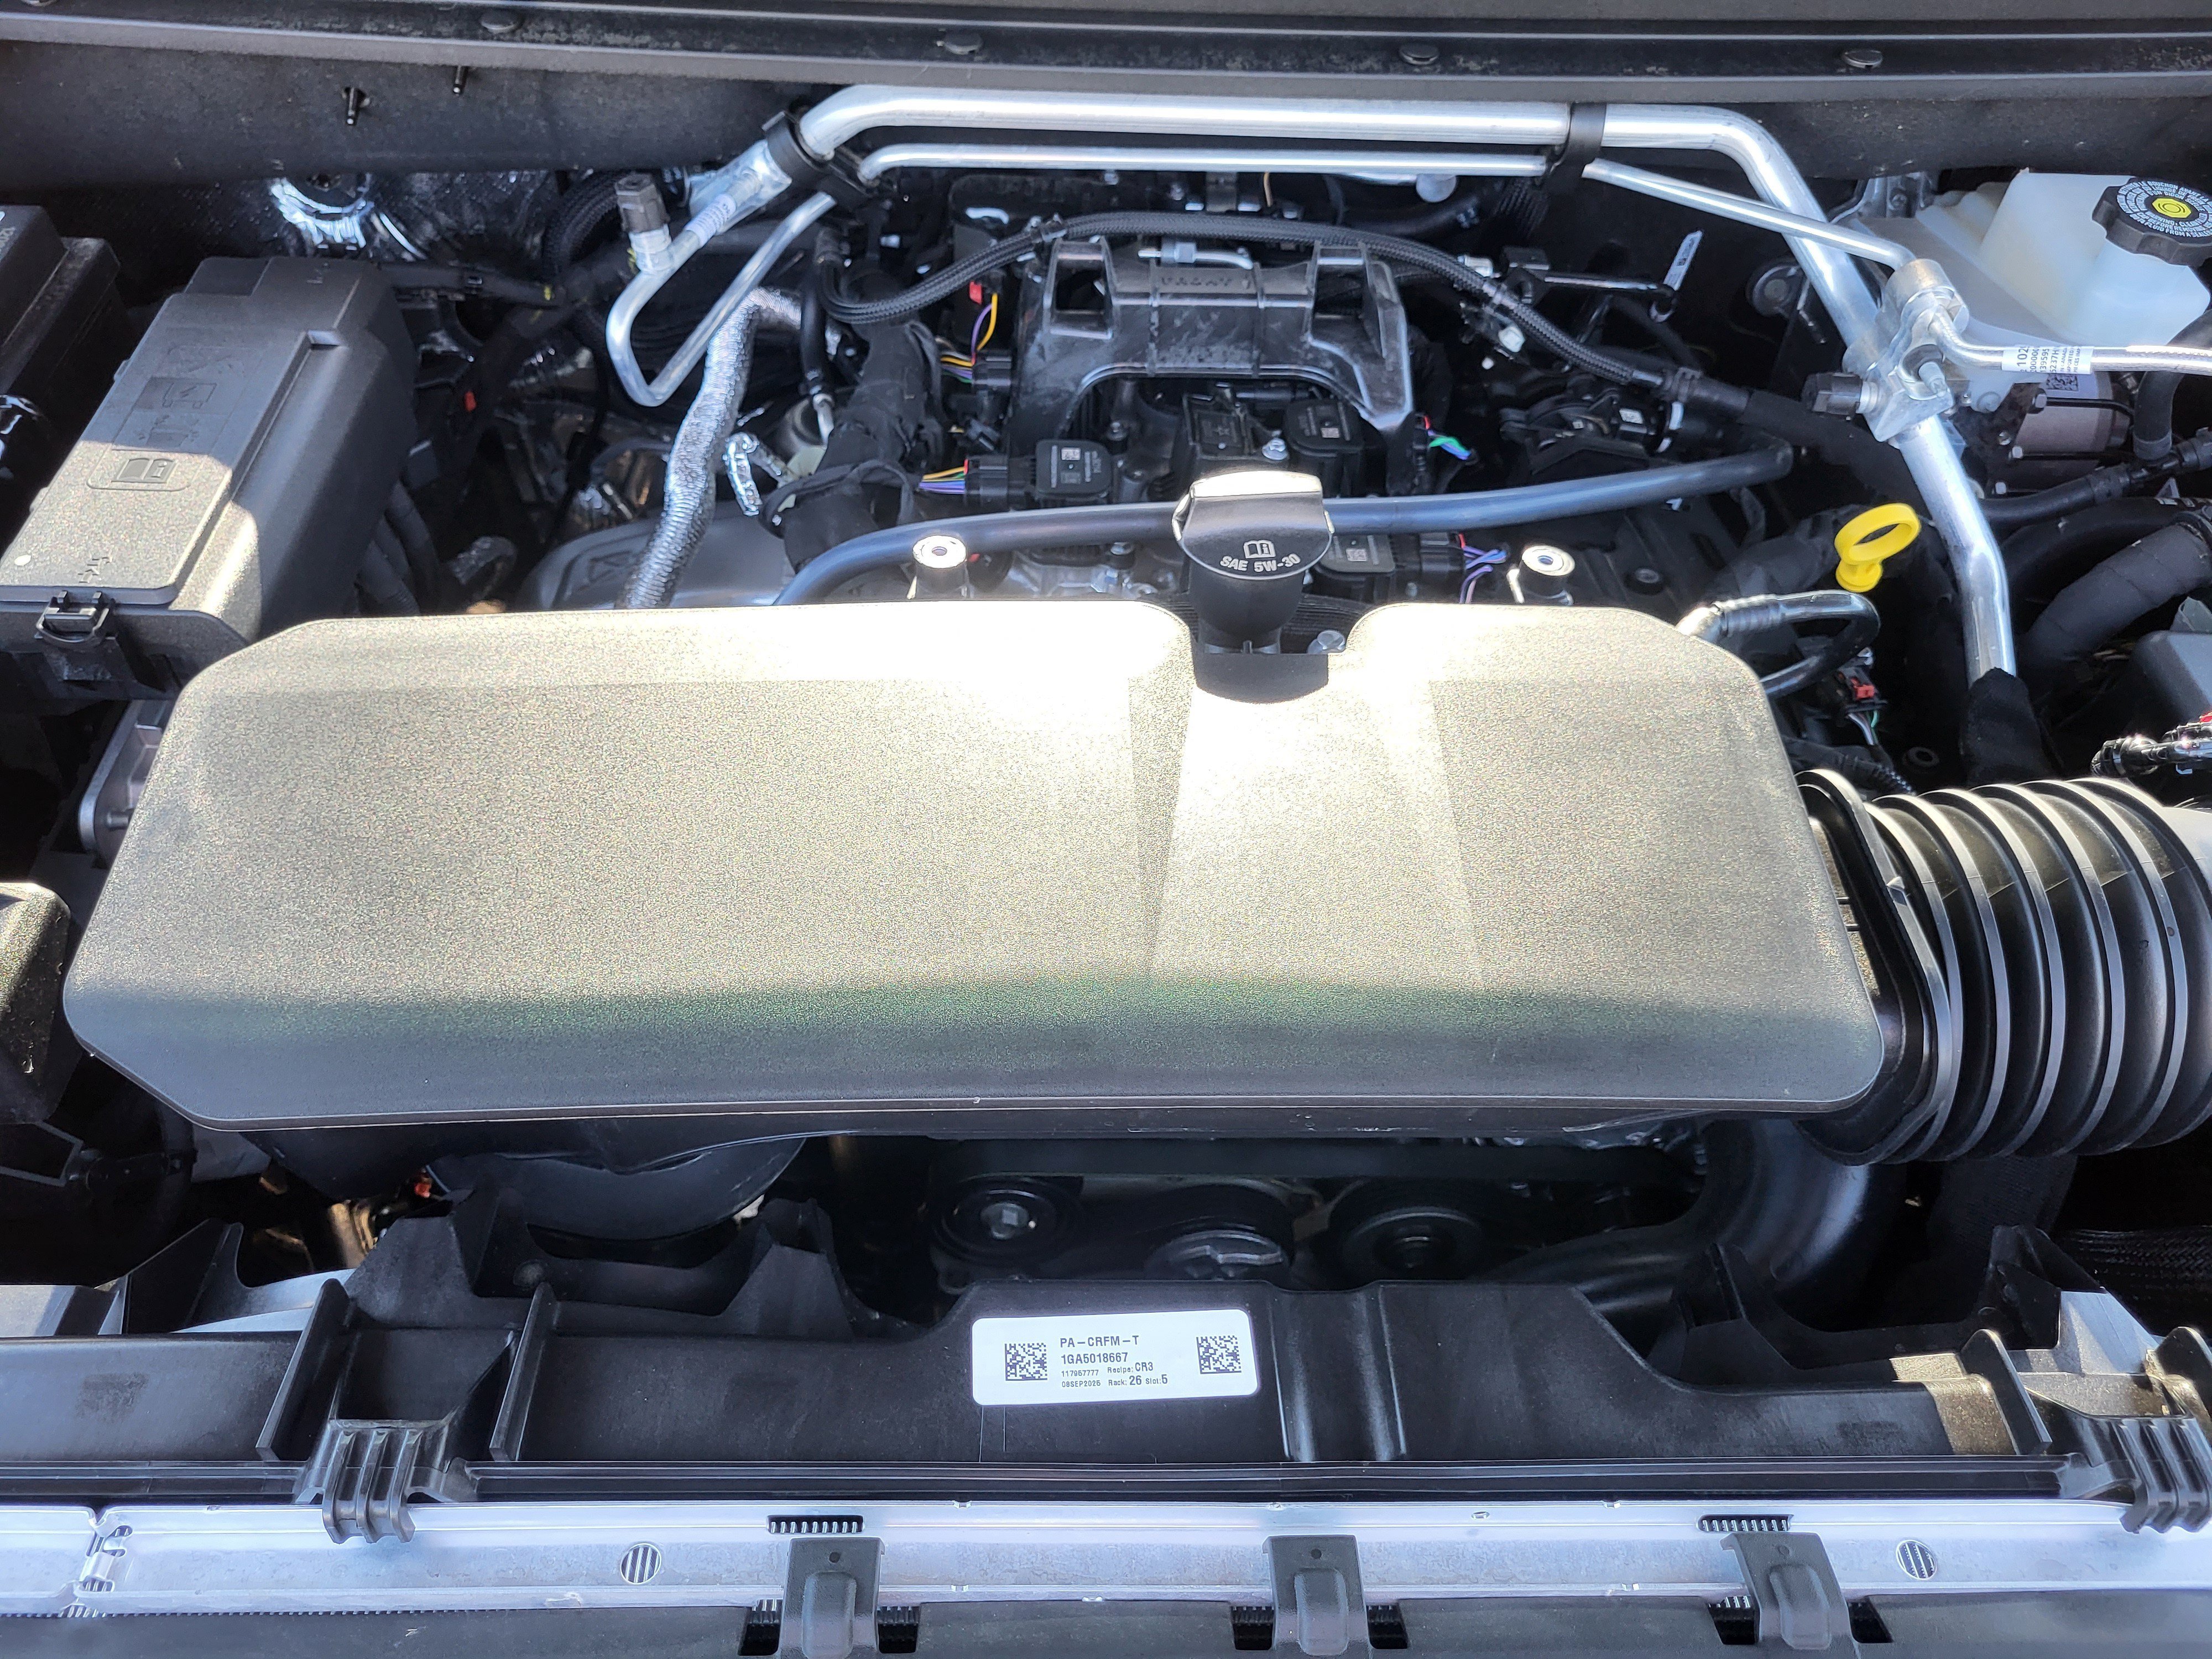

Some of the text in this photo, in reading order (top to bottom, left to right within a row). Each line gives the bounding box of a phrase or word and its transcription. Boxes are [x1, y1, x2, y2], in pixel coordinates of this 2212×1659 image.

[2165, 228, 2185, 237] FROM
[1220, 554, 1301, 572] SAE 5W-30
[1061, 1352, 1128, 1364] 1GA5018667
[1135, 1361, 1154, 1371] CR3
[1129, 1375, 1142, 1385] 26
